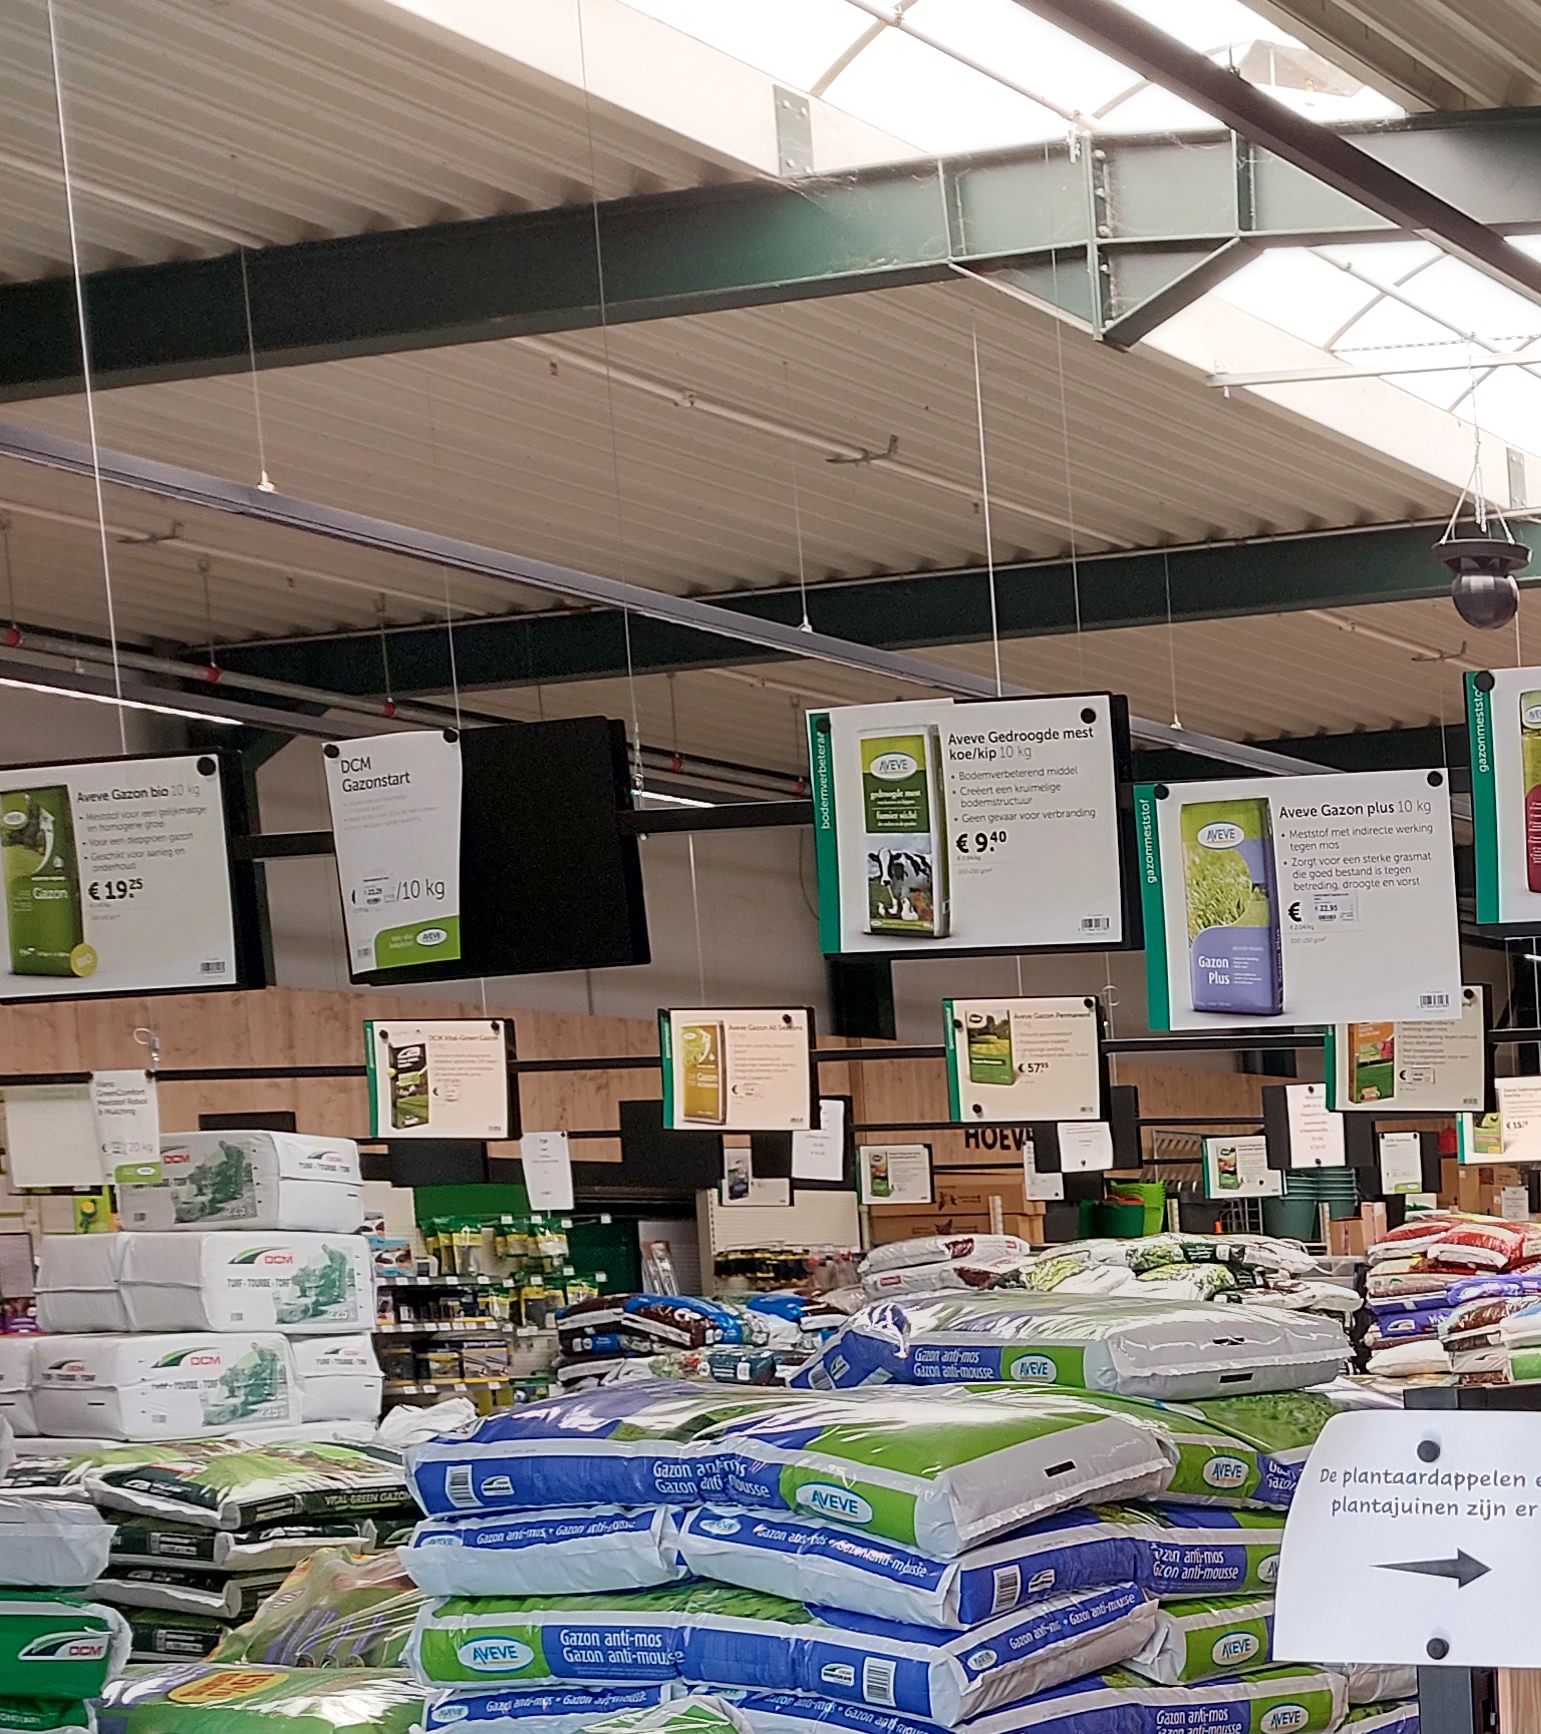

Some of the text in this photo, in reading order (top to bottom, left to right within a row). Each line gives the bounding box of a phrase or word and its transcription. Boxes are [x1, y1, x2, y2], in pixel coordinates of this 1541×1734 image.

[948, 728, 1094, 745] Aveve Gedroogde mest
[950, 746, 1032, 761] koe/kip 10 kg
[341, 757, 371, 774] DCM
[959, 767, 1078, 781] Bodemverbeterend middel
[342, 772, 411, 792] Gazonstart
[996, 786, 1012, 794] een
[1014, 783, 1061, 793] kruimelige
[77, 785, 199, 802] Aveve Gazon bio 10 kg
[961, 797, 1032, 808] bodemstructuur
[1279, 800, 1432, 819] Aveve Gazon plus 10 kg
[962, 808, 1096, 823] Geen gevaar voor verbranding
[1290, 824, 1433, 839] Meststof met indirecte werking
[1290, 843, 1317, 852] tegen
[1292, 853, 1432, 868] Zorgt voor een sterke grasmat
[1293, 866, 1411, 880] die goed bestand is tegen
[426, 879, 445, 900] kg
[1343, 879, 1380, 890] droogte
[1383, 879, 1394, 887] en
[1398, 877, 1420, 886] vorst
[1198, 956, 1229, 969] Gazon
[1208, 971, 1230, 985] Plus
[164, 1155, 190, 1163] DCM
[265, 1255, 293, 1264] DCM
[915, 1348, 979, 1365] Gazon anti-mos
[914, 1363, 993, 1379] Gazon anti-mousse
[1319, 1467, 1337, 1484] De
[1342, 1468, 1526, 1492] plantaardappelen
[1332, 1497, 1538, 1521] plantajuinen zijn er
[560, 1630, 662, 1648] Gazon anti-mos
[563, 1648, 684, 1665] Gazon anti-mousse
